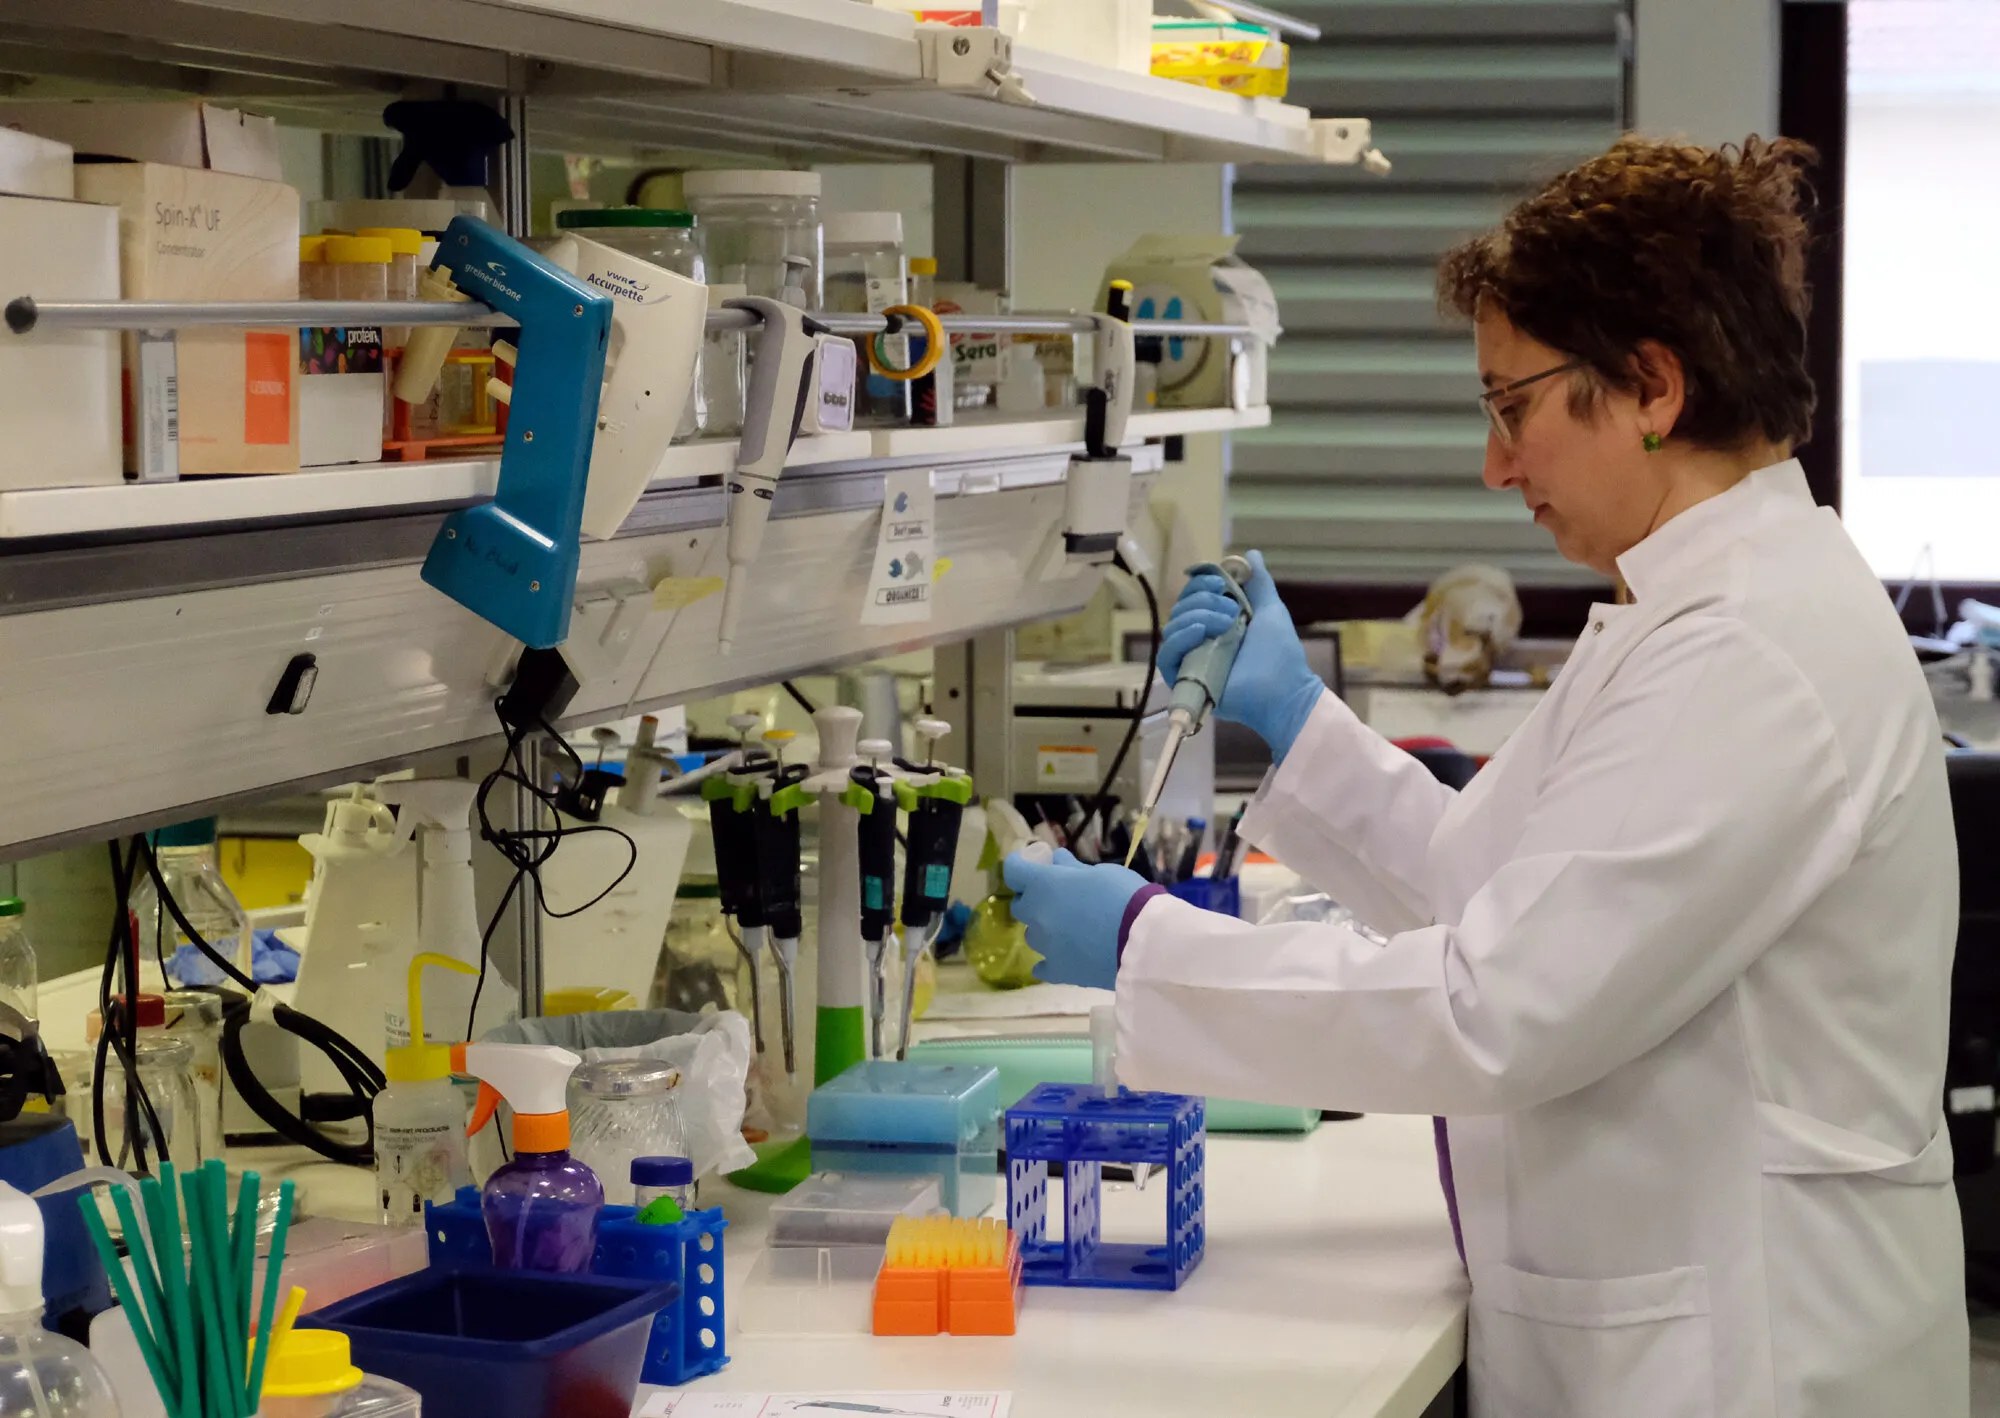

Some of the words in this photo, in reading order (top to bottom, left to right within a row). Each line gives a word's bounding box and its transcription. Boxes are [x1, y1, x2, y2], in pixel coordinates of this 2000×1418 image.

[205, 208, 221, 231] UF
[586, 273, 644, 303] Accurpette
[955, 343, 997, 362] Sera
